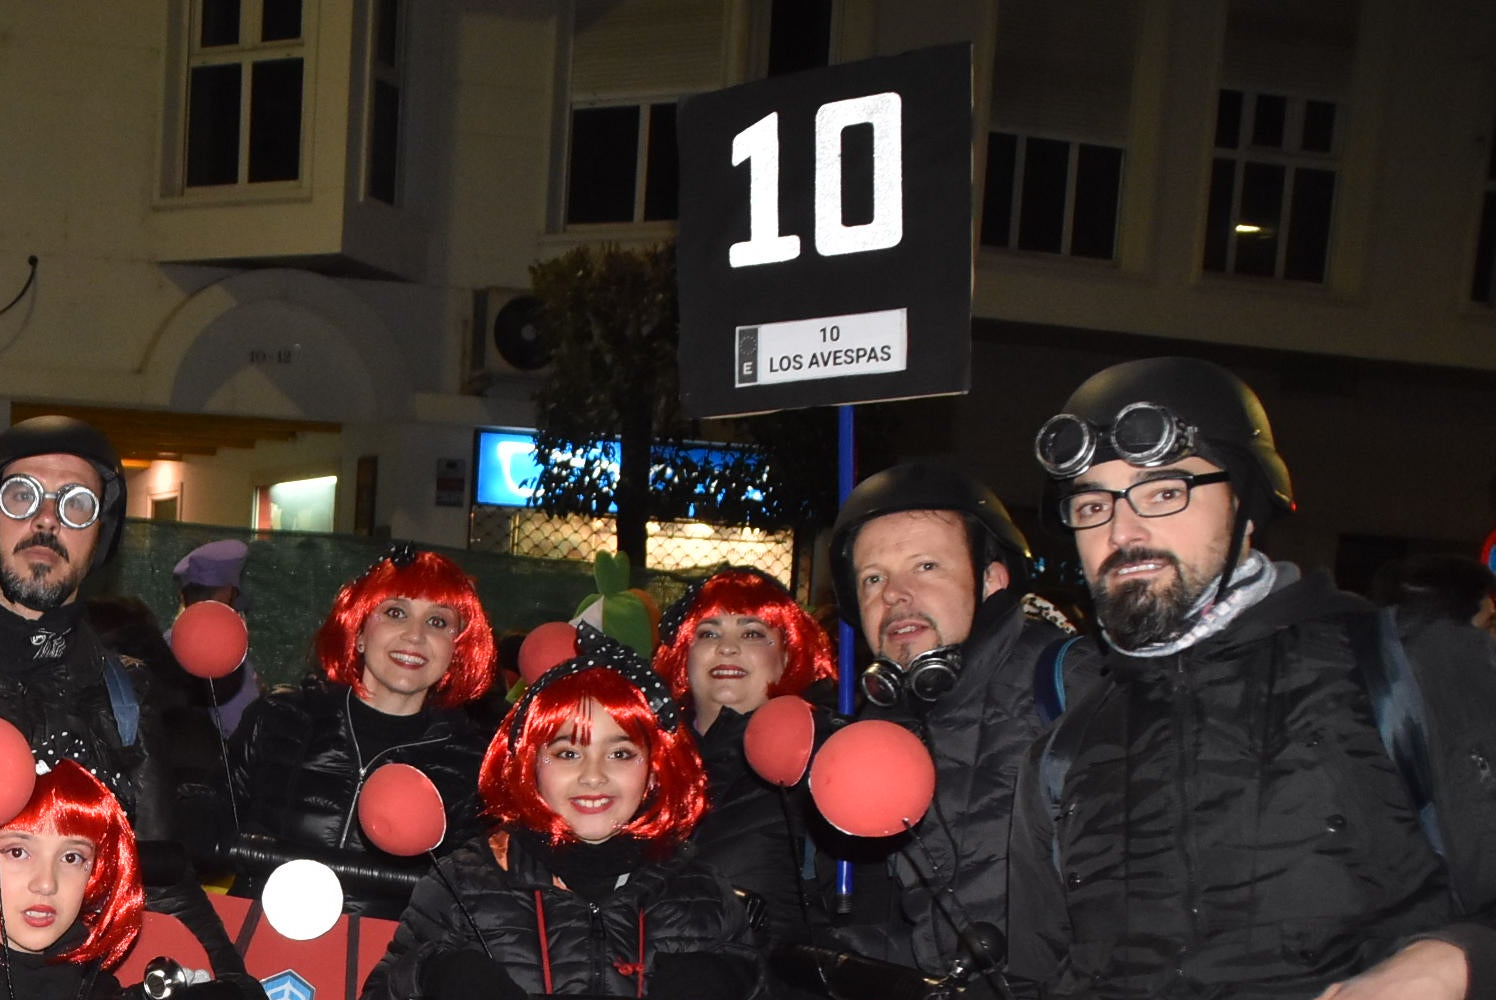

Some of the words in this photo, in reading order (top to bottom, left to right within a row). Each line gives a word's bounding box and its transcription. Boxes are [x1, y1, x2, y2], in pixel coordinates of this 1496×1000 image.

[729, 91, 903, 268] 10
[819, 325, 841, 343] 10
[742, 361, 753, 375] E
[768, 354, 804, 373] LOS
[807, 345, 892, 369] AVESPAS
